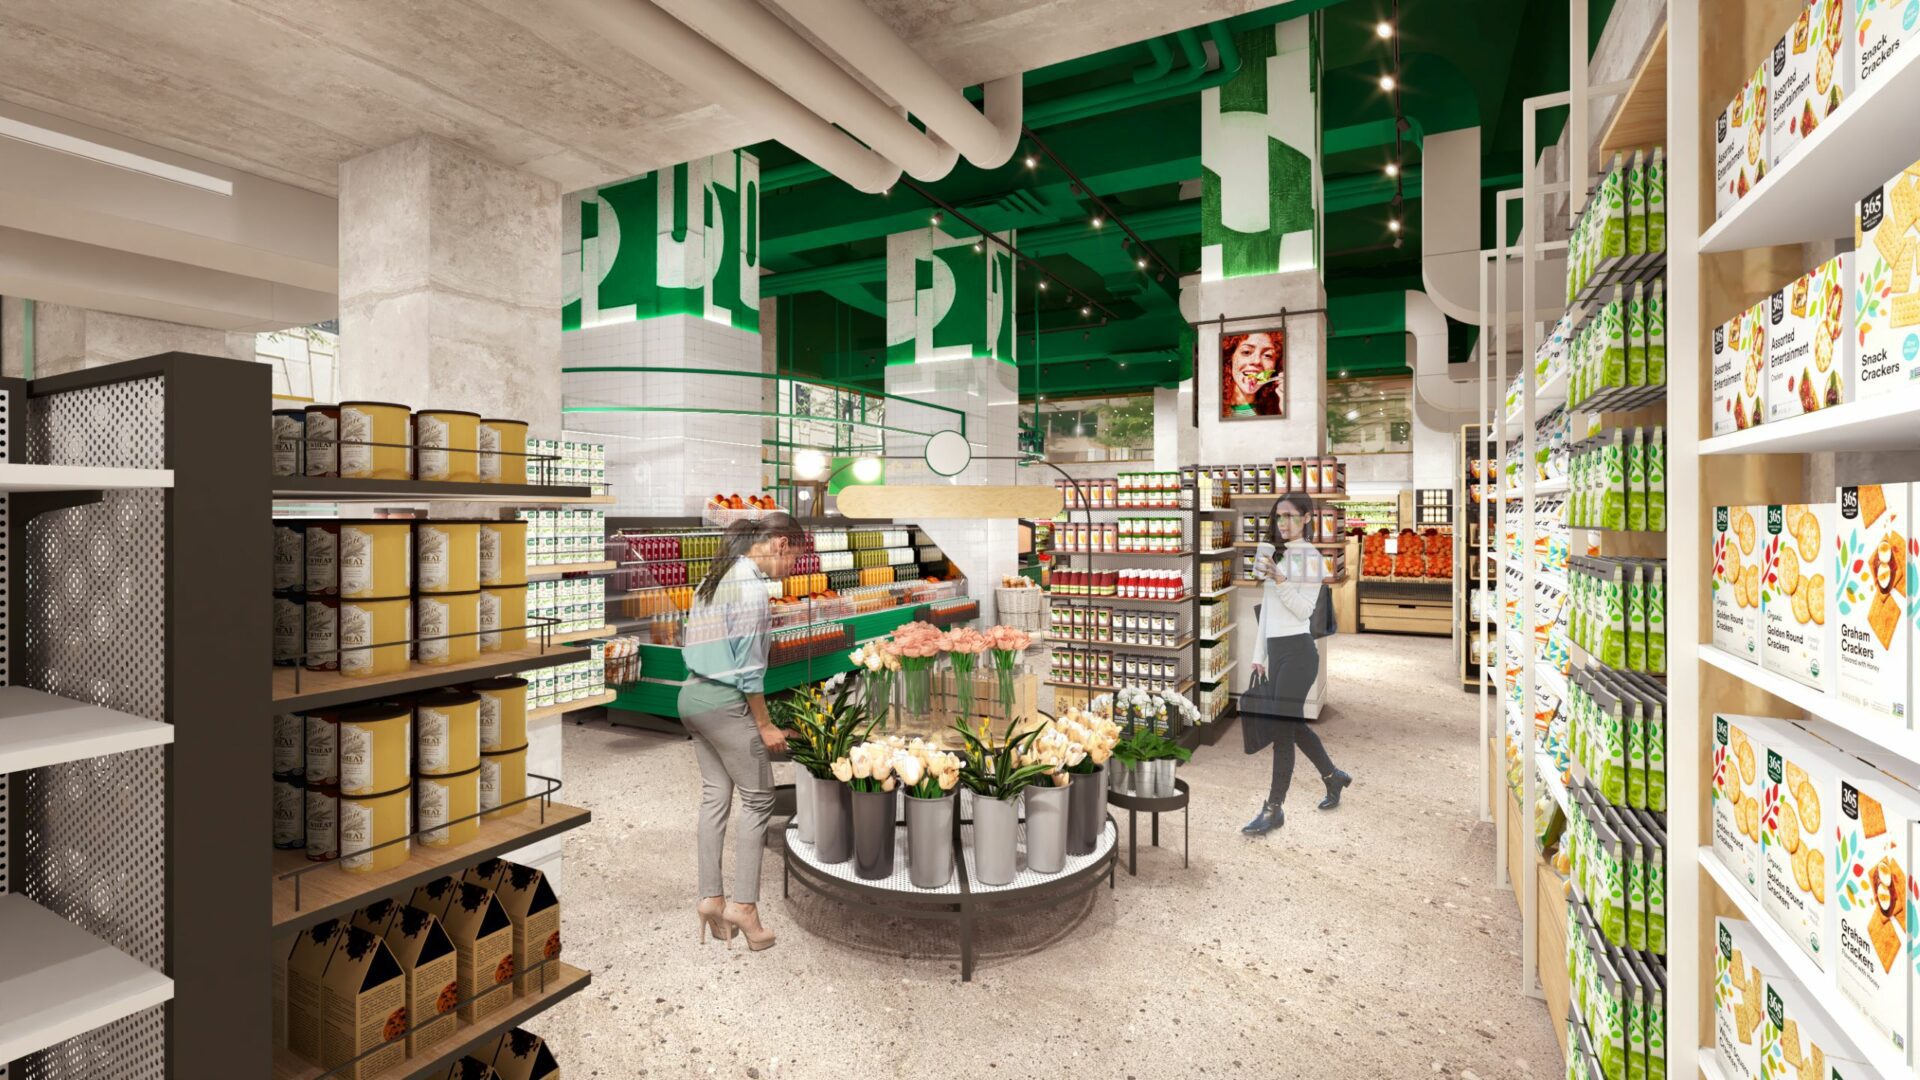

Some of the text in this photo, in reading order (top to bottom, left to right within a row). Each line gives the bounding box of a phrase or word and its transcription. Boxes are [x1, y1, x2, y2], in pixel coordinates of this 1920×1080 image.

[1861, 38, 1900, 80] Crackers
[1862, 34, 1888, 66] Snack
[1774, 67, 1797, 101] Assorted
[1773, 72, 1810, 121] Entertainment
[1717, 146, 1745, 181] Entertainment
[1718, 141, 1735, 164] Assorted
[1862, 194, 1882, 221] 365
[1771, 328, 1795, 351] Assorted
[1771, 343, 1809, 368] Entertainment
[1861, 348, 1888, 367] Snack
[1714, 359, 1732, 376] Assorted
[1861, 361, 1900, 382] Crackers
[1714, 371, 1742, 391] Entertainment
[1842, 490, 1858, 508] 365
[1717, 510, 1727, 524] 365
[1768, 510, 1781, 524] 365
[1716, 609, 1730, 620] Golden
[1730, 613, 1744, 625] Round
[1716, 620, 1734, 633] Crackers
[1767, 625, 1785, 638] Golden
[1786, 630, 1804, 644] Round
[1767, 637, 1790, 653] Crackers
[1841, 624, 1871, 643] Graham
[1841, 639, 1874, 659] Crackers
[1717, 721, 1728, 737] 365
[1768, 756, 1781, 774] 365
[1842, 788, 1858, 810] 365
[1716, 819, 1744, 850] Golden Round
[1716, 829, 1734, 853] Crackers
[1766, 882, 1791, 910] Crackers
[1767, 869, 1804, 910] Golden Round
[1841, 918, 1871, 953] Graham
[1841, 934, 1875, 973] Crackers
[1768, 992, 1783, 1020] 365
[1719, 1036, 1738, 1072] Crackers
